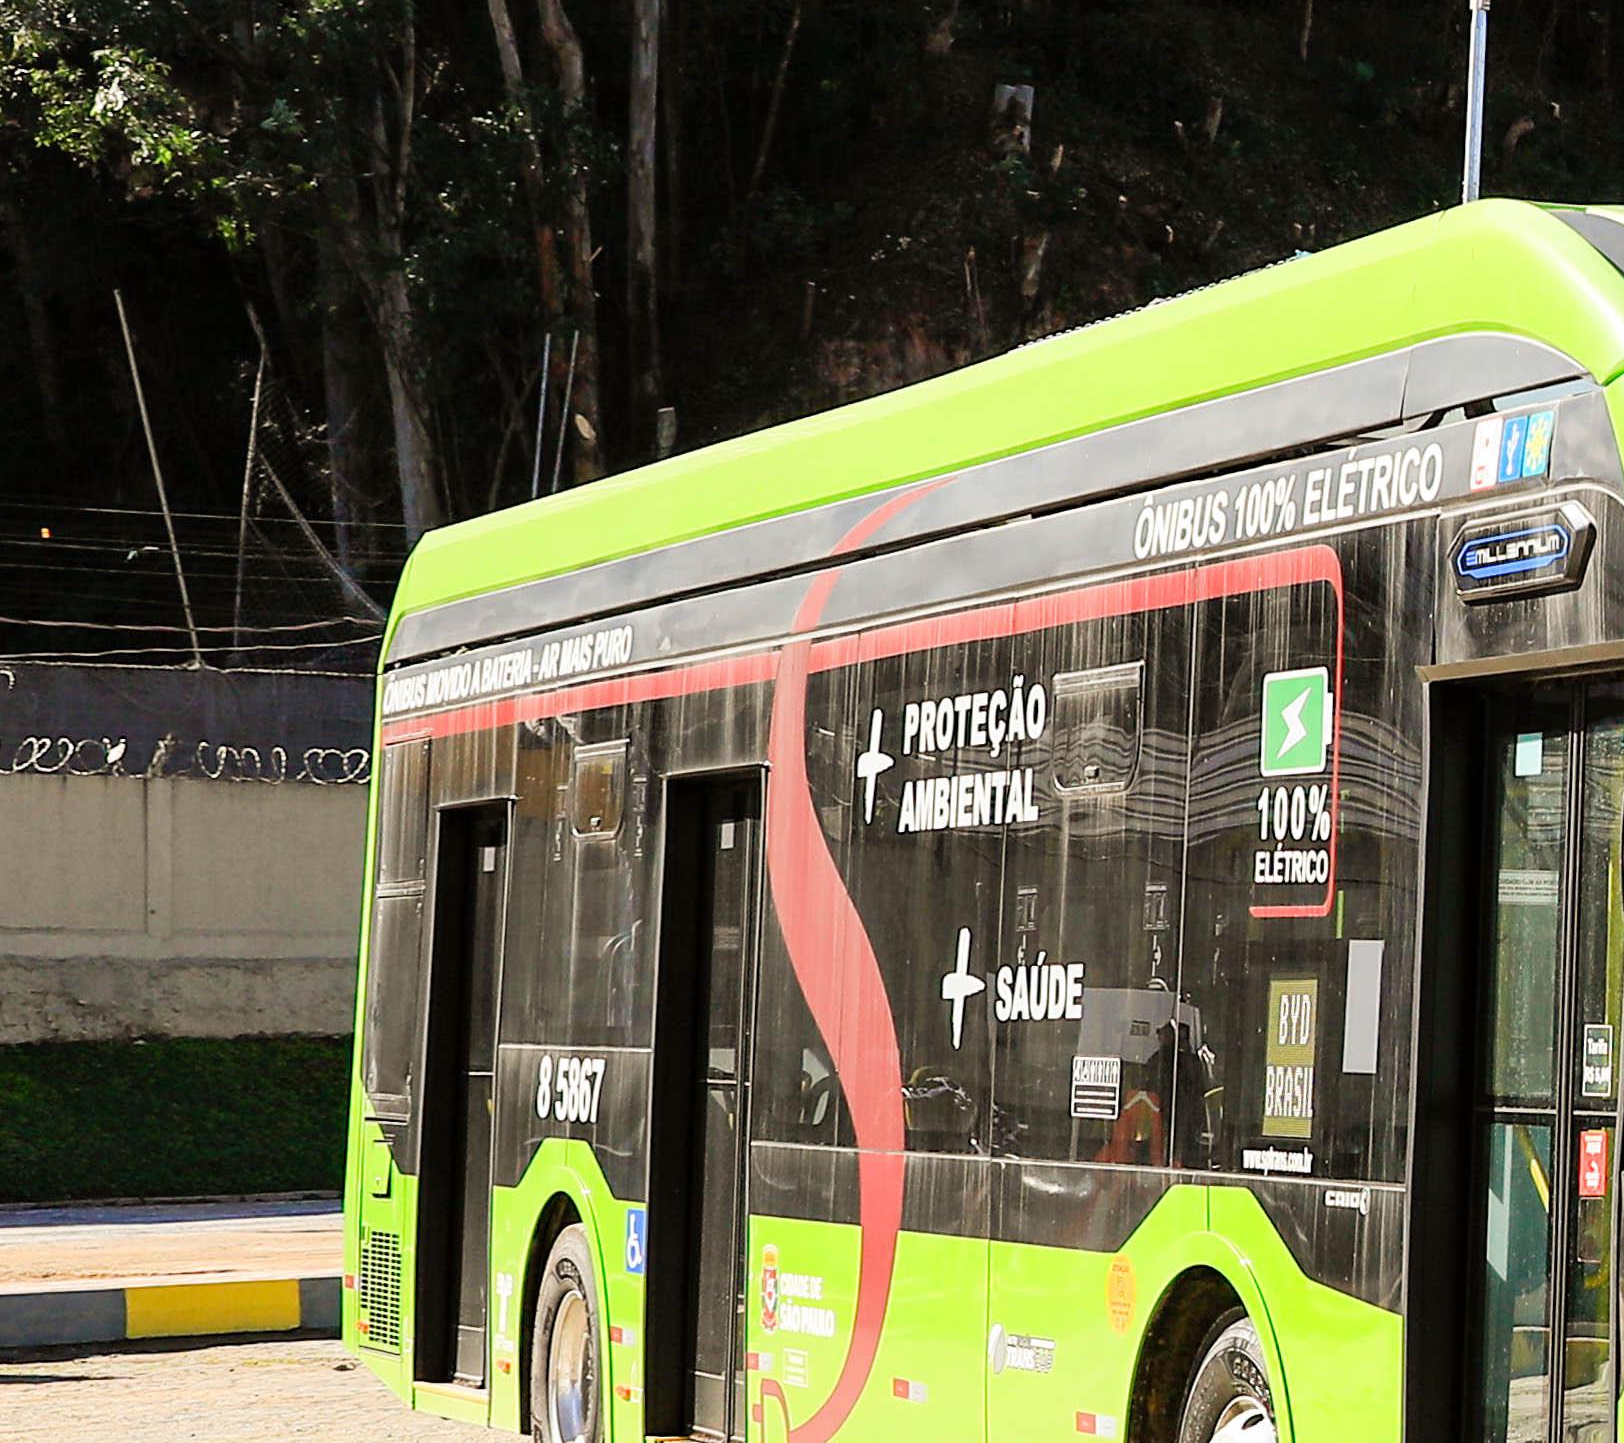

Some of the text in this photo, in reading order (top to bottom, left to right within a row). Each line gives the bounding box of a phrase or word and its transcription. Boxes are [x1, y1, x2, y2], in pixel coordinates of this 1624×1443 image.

[1133, 442, 1443, 560] ÔNIBUS 100% ELÉTRICO
[481, 648, 533, 693] BATERIA
[903, 675, 1046, 758] PROTEÇÃO
[898, 768, 1039, 833] AMBIENTAL
[1257, 784, 1331, 841] 100%
[1254, 842, 1329, 883] ELÉTRICO
[995, 951, 1084, 1021] SAÚDE
[1278, 994, 1311, 1045] BYD
[536, 1055, 606, 1124] 8 5867
[1265, 1066, 1314, 1118] BRASIL
[1324, 1189, 1360, 1210] CAIO
